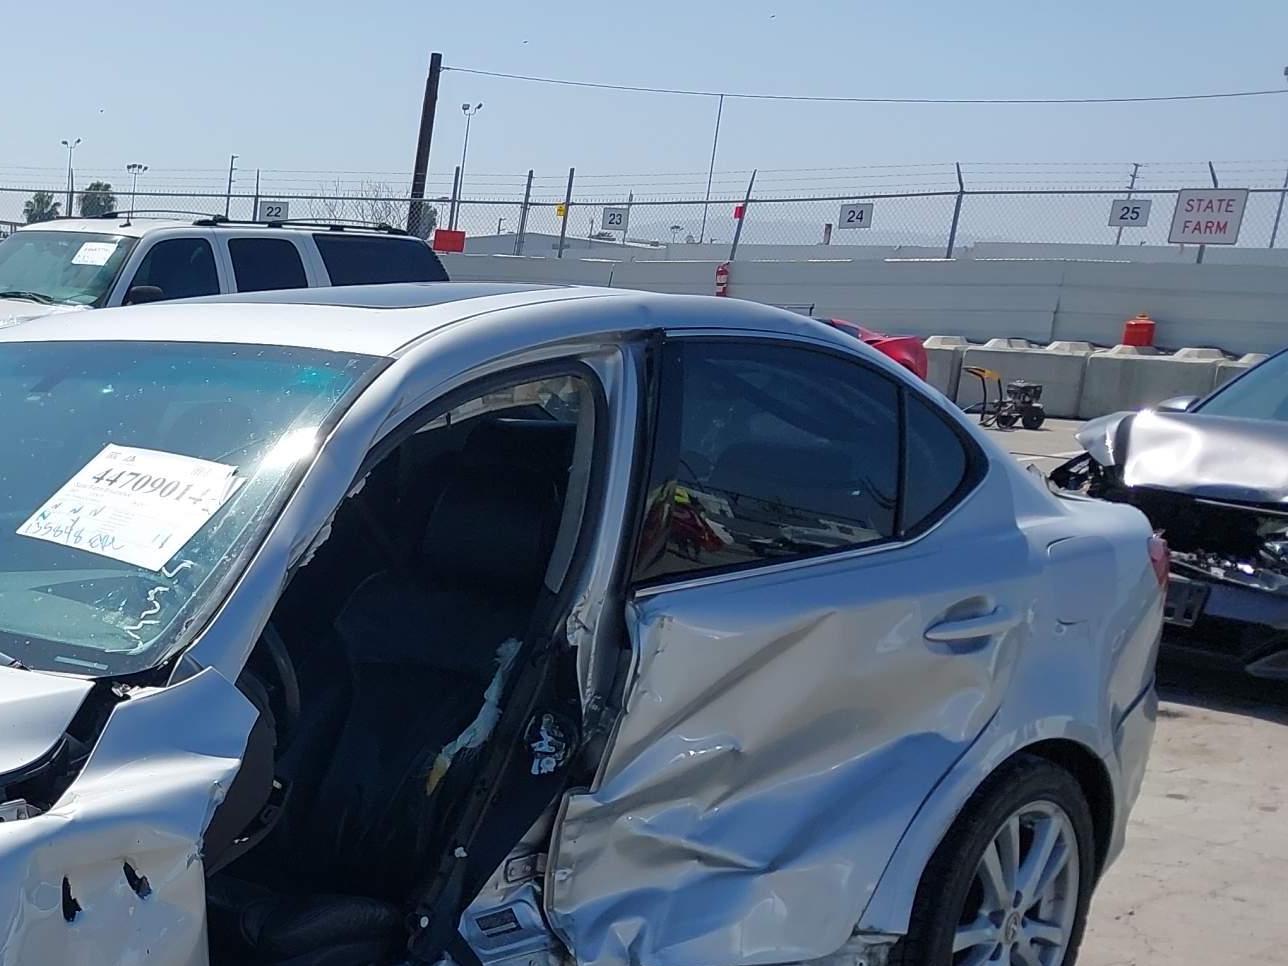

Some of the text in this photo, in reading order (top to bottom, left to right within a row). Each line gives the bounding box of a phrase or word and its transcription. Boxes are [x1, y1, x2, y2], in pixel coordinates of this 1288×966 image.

[266, 206, 282, 217] 22
[1184, 199, 1236, 213] STATE
[608, 213, 623, 225] 23
[846, 209, 864, 223] 24
[1119, 206, 1141, 221] 25
[1181, 221, 1229, 235] FARM
